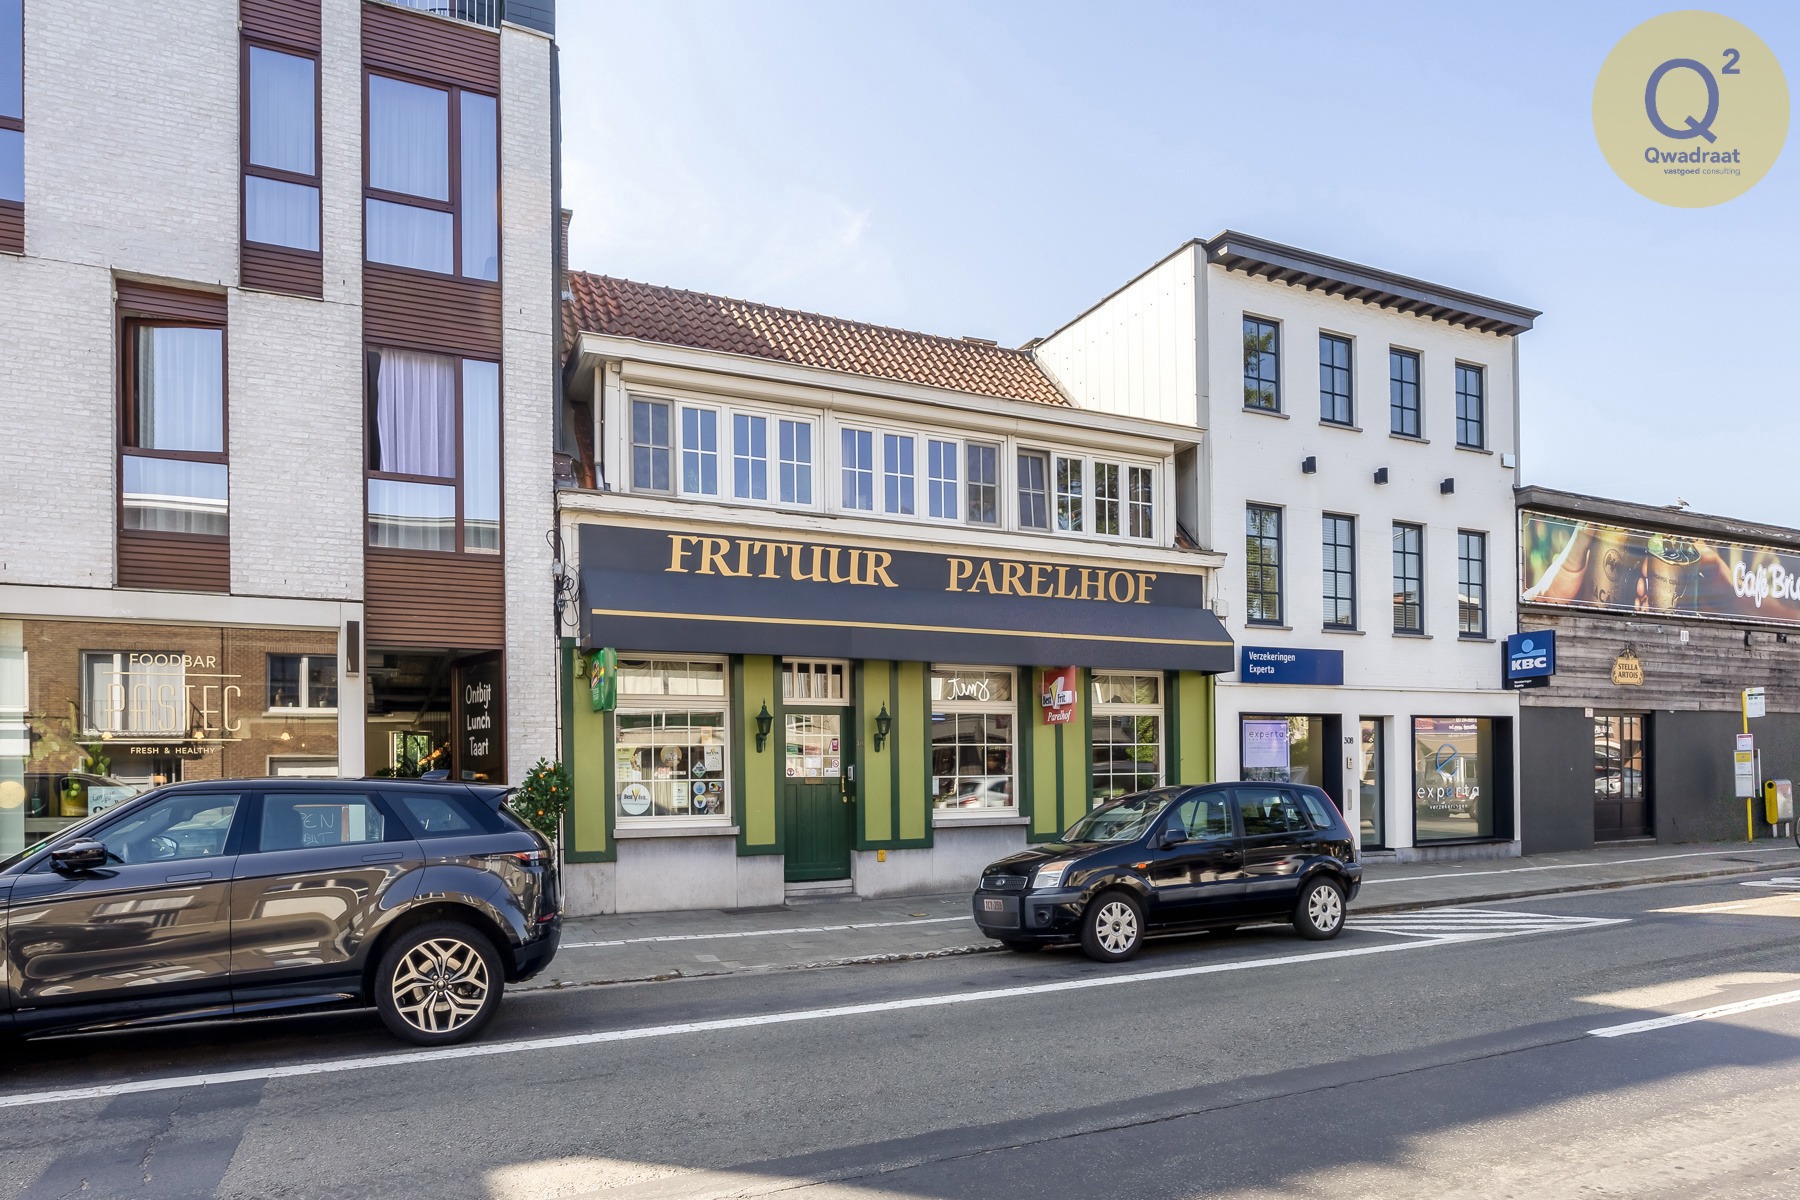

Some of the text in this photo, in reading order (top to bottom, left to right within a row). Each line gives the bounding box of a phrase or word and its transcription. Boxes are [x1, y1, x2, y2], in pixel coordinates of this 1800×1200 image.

[664, 534, 1157, 604] FRITUUR PARELHOF
[1733, 560, 1769, 608] Café
[129, 653, 216, 668] FOODBAR
[1249, 651, 1296, 664] Verzekeringen
[1511, 657, 1547, 671] KBC
[1249, 664, 1275, 675] Experta
[1618, 663, 1638, 671] STELLA
[1618, 671, 1639, 679] ARTOIS
[465, 682, 492, 709] Ontbijt
[105, 683, 242, 732] PASTEC
[466, 711, 491, 731] Lunch
[1047, 709, 1072, 722] Parelhof
[1249, 731, 1284, 740] experta
[1344, 737, 1354, 745] 308
[130, 747, 216, 755] FRESH & HEALTHY
[469, 736, 489, 756] Taart
[1417, 785, 1480, 802] experta
